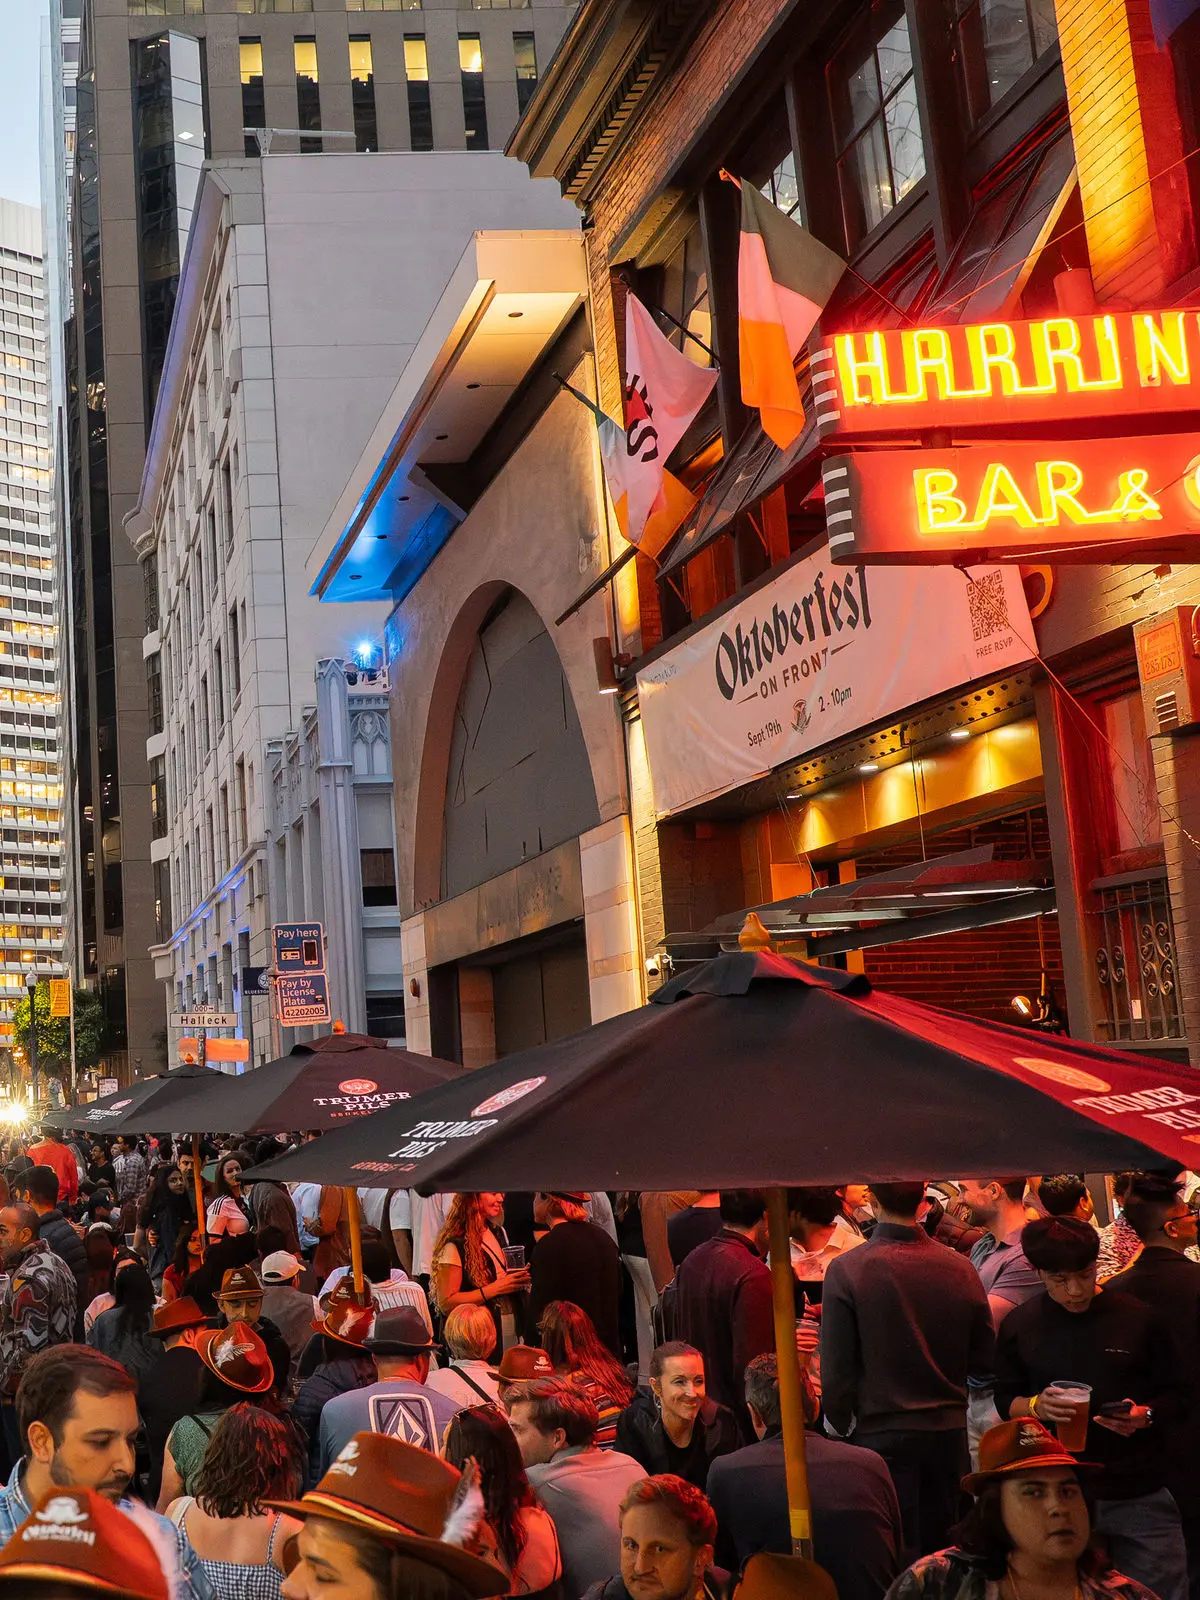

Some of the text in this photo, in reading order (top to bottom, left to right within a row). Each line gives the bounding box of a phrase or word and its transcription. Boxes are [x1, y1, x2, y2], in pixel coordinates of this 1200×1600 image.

[834, 311, 1200, 407] HARRIN
[913, 461, 1088, 534] BAR
[1110, 468, 1163, 523] &
[715, 565, 872, 701] Oktoberfest
[975, 636, 1013, 658] FREE RSVP
[760, 648, 828, 699] ON FRONT
[747, 728, 766, 747] Sept
[765, 719, 783, 738] 19th
[818, 696, 826, 713] 2
[831, 687, 852, 707] 10pm
[277, 928, 319, 941] Pay here
[281, 978, 312, 989] Pay by
[282, 988, 316, 997] License
[283, 997, 306, 1006] Plate
[180, 1016, 228, 1025] Halleck
[285, 1007, 325, 1017] 42202005
[313, 1091, 412, 1107] TRUMER
[343, 1101, 391, 1111] PILS
[1071, 1086, 1200, 1115] TRUMER
[400, 1118, 499, 1139] TRUMER
[387, 1140, 447, 1158] PILS
